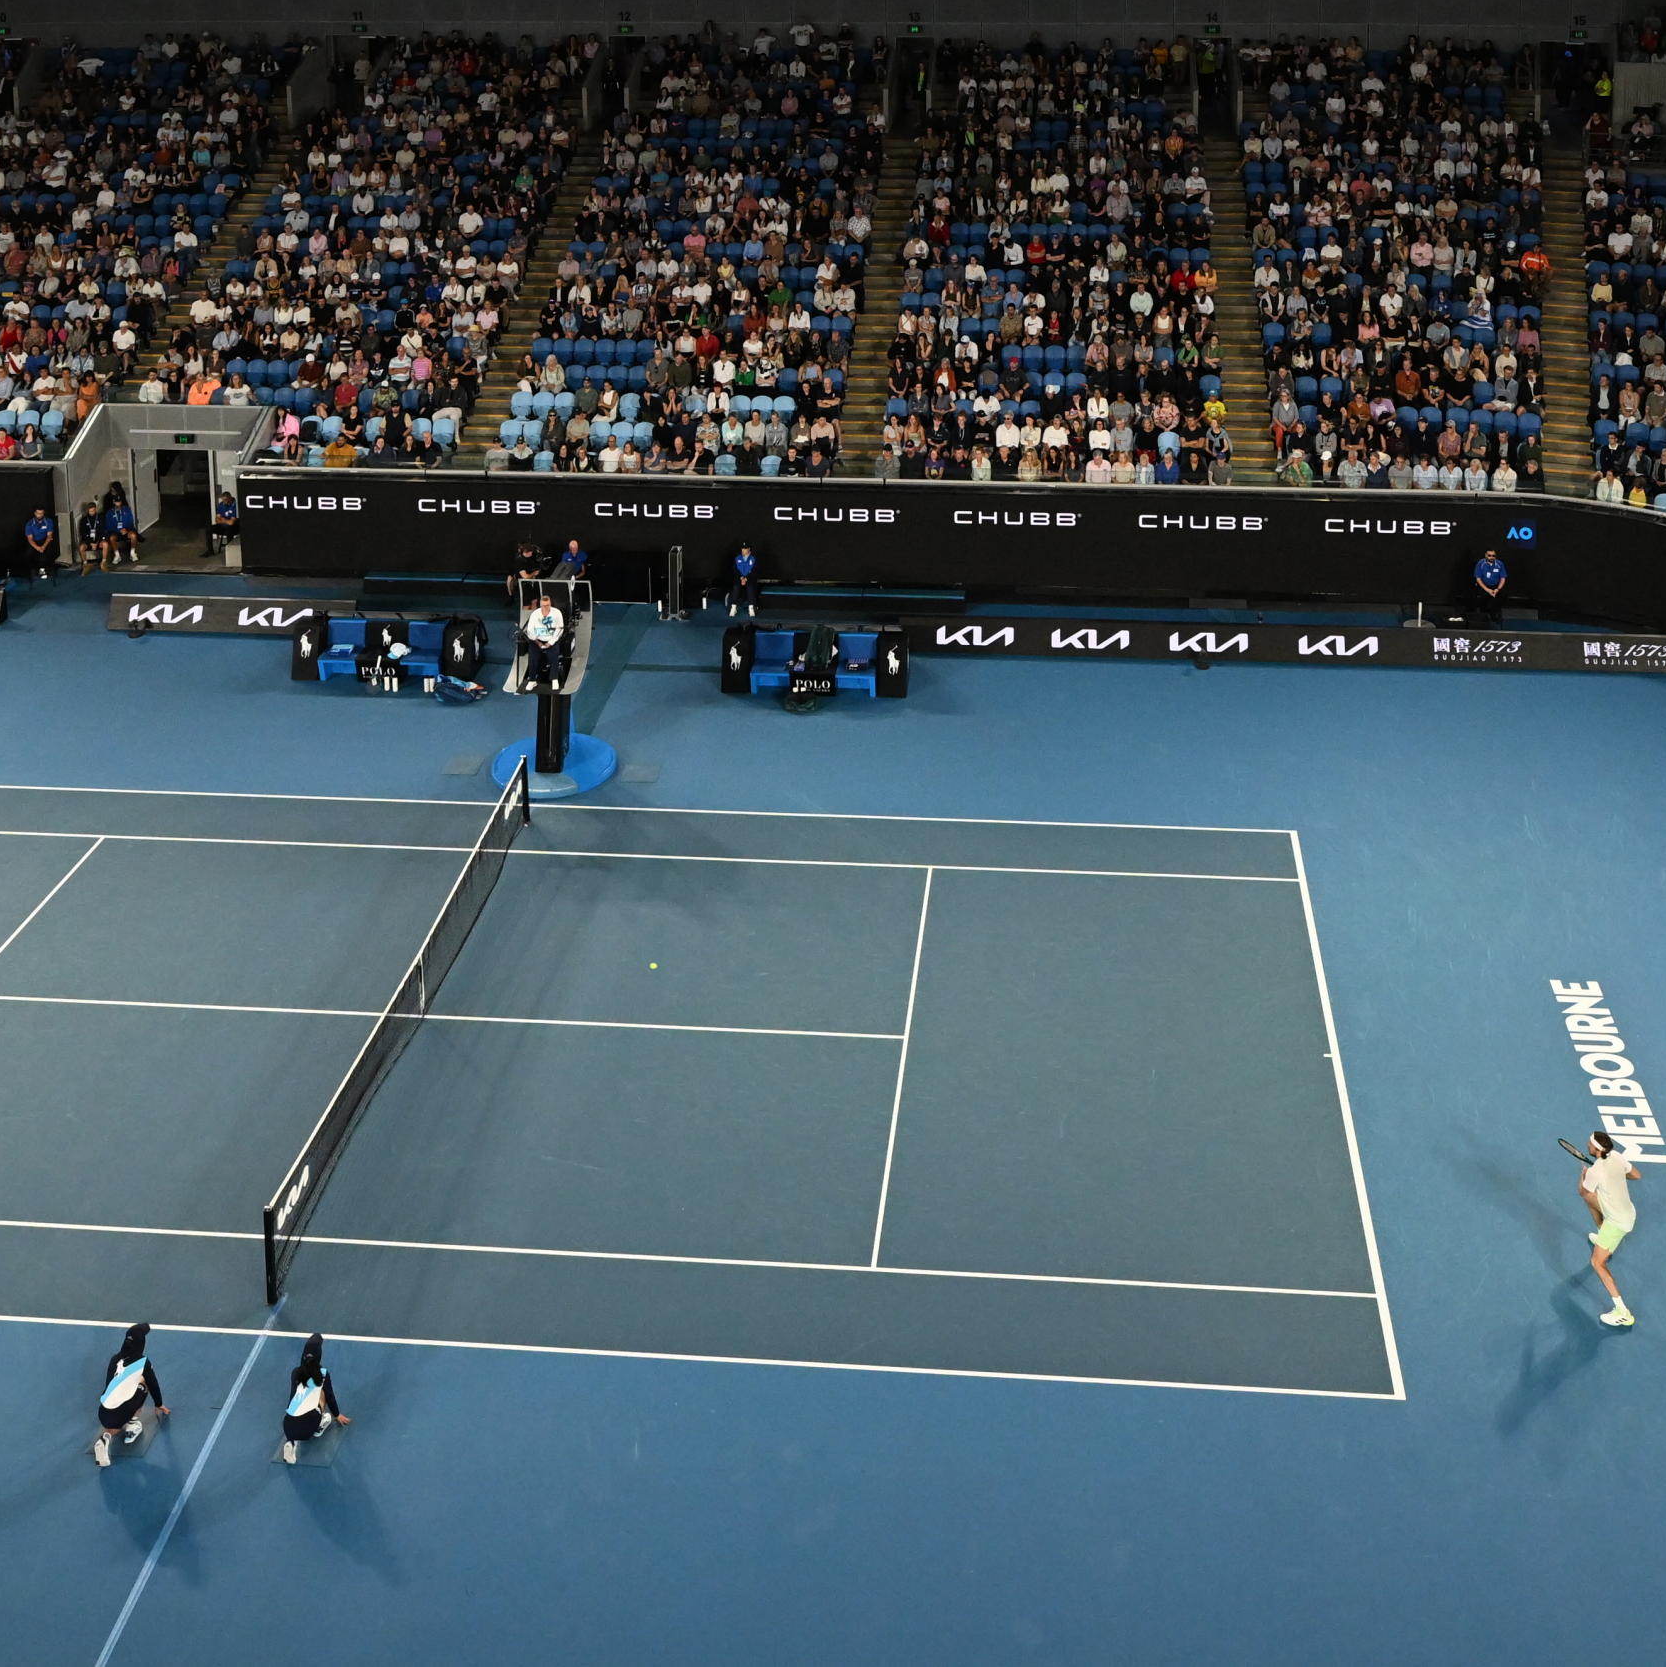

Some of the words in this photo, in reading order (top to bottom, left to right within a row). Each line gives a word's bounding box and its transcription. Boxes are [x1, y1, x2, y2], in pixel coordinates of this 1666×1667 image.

[352, 11, 363, 21] 11
[620, 12, 631, 22] 12
[909, 12, 921, 22] 13
[1205, 13, 1218, 23] 14
[1574, 16, 1587, 26] 15
[1507, 527, 1533, 540] AO
[129, 604, 204, 625] KIA
[936, 625, 1015, 647] KIA
[1051, 628, 1130, 650] KIA
[1169, 632, 1249, 653] KIA
[1298, 635, 1379, 657] KIA
[1495, 655, 1522, 663] 1573
[361, 666, 396, 676] POLO
[795, 679, 831, 689] POLO
[277, 1164, 309, 1231] KIA
